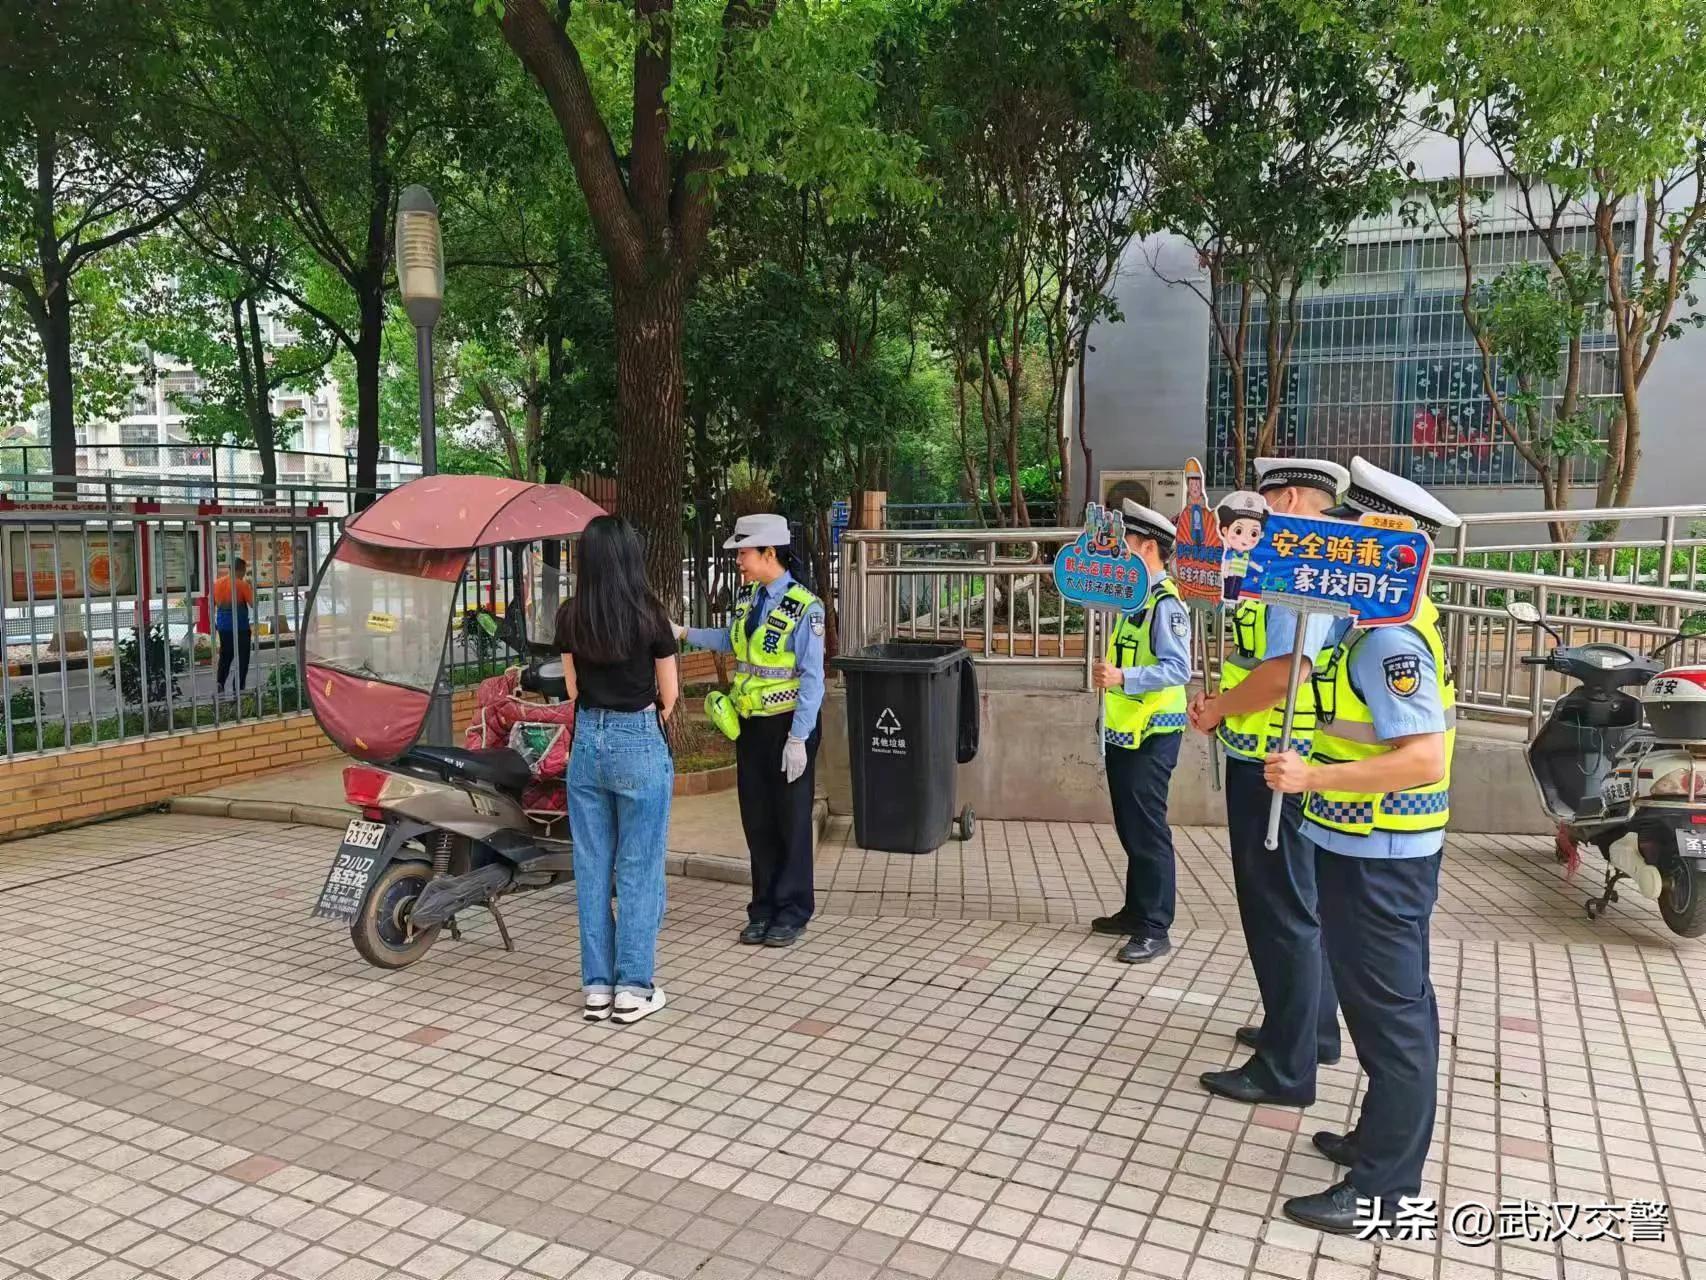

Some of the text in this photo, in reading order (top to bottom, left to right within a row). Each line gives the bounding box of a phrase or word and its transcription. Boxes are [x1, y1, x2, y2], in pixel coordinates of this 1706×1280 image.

[1371, 516, 1404, 528] 交通安全
[1271, 528, 1384, 567] 安全骑乘
[1064, 556, 1140, 583] 戴头盔更安全
[1065, 576, 1135, 600] 大人孩子都需要
[1293, 564, 1409, 604] 家校同行
[872, 737, 906, 749] 其他垃圾
[346, 830, 379, 847] 23794
